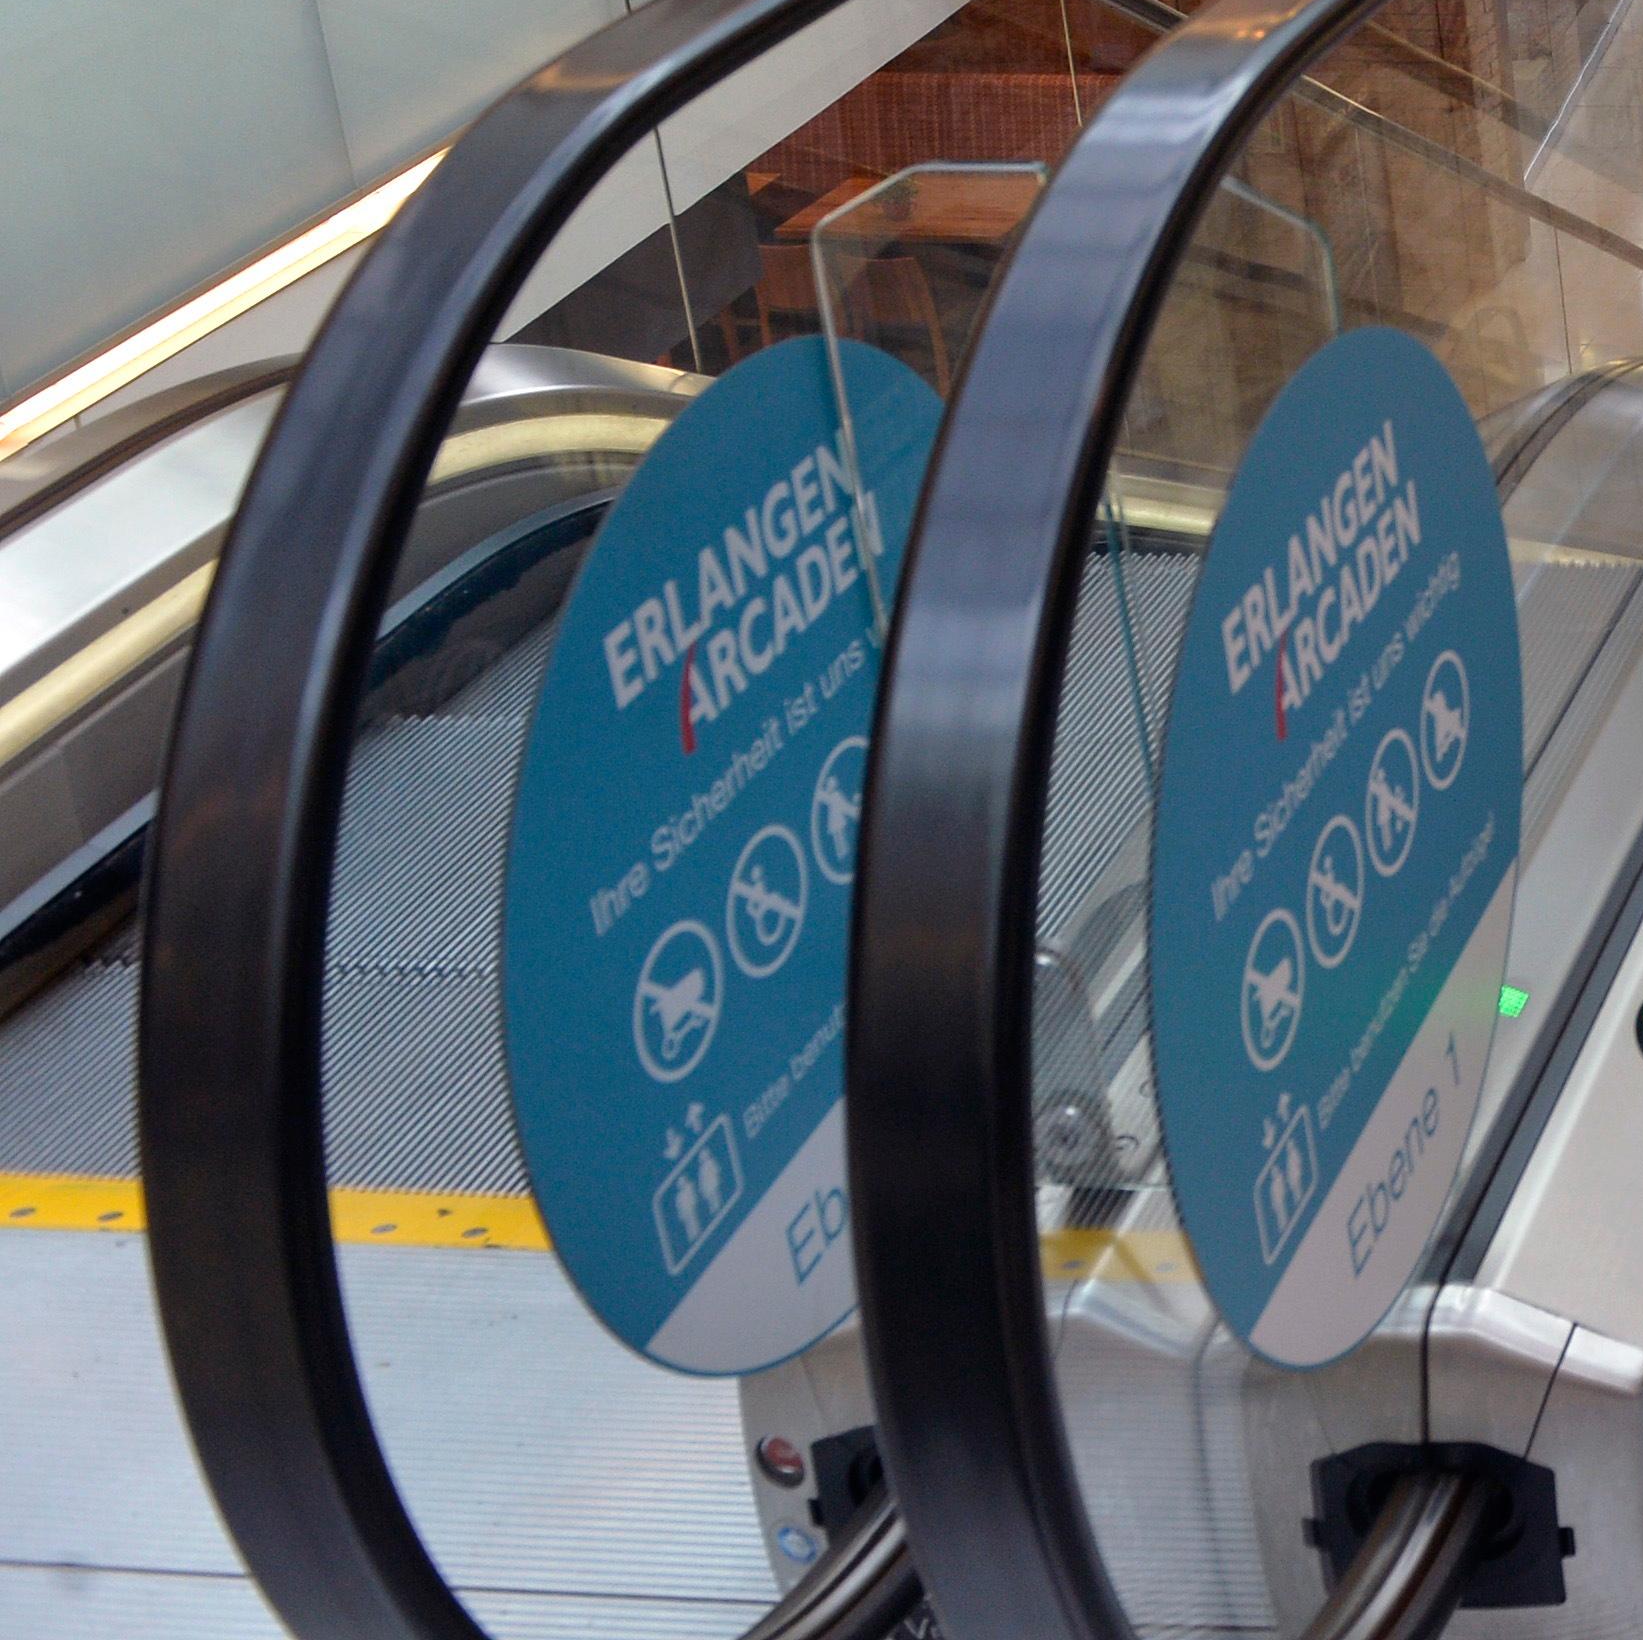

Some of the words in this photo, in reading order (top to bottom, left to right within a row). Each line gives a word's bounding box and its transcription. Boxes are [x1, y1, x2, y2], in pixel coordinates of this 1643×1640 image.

[602, 442, 854, 709] ERLANGEN
[678, 499, 885, 754] ARCADEN
[1222, 419, 1398, 694] ERLANGEN
[1274, 479, 1421, 740] ARCADEN
[589, 857, 649, 935] Ihre
[651, 714, 783, 875] Sicherheit
[784, 685, 816, 740] ist
[819, 644, 867, 705] uns
[1212, 838, 1255, 922] Ihre
[1255, 708, 1349, 869] Sicherheit
[1347, 673, 1373, 733] ist
[1372, 635, 1408, 692] uns
[1407, 551, 1461, 647] wichtig
[1347, 1101, 1441, 1274] Ebene
